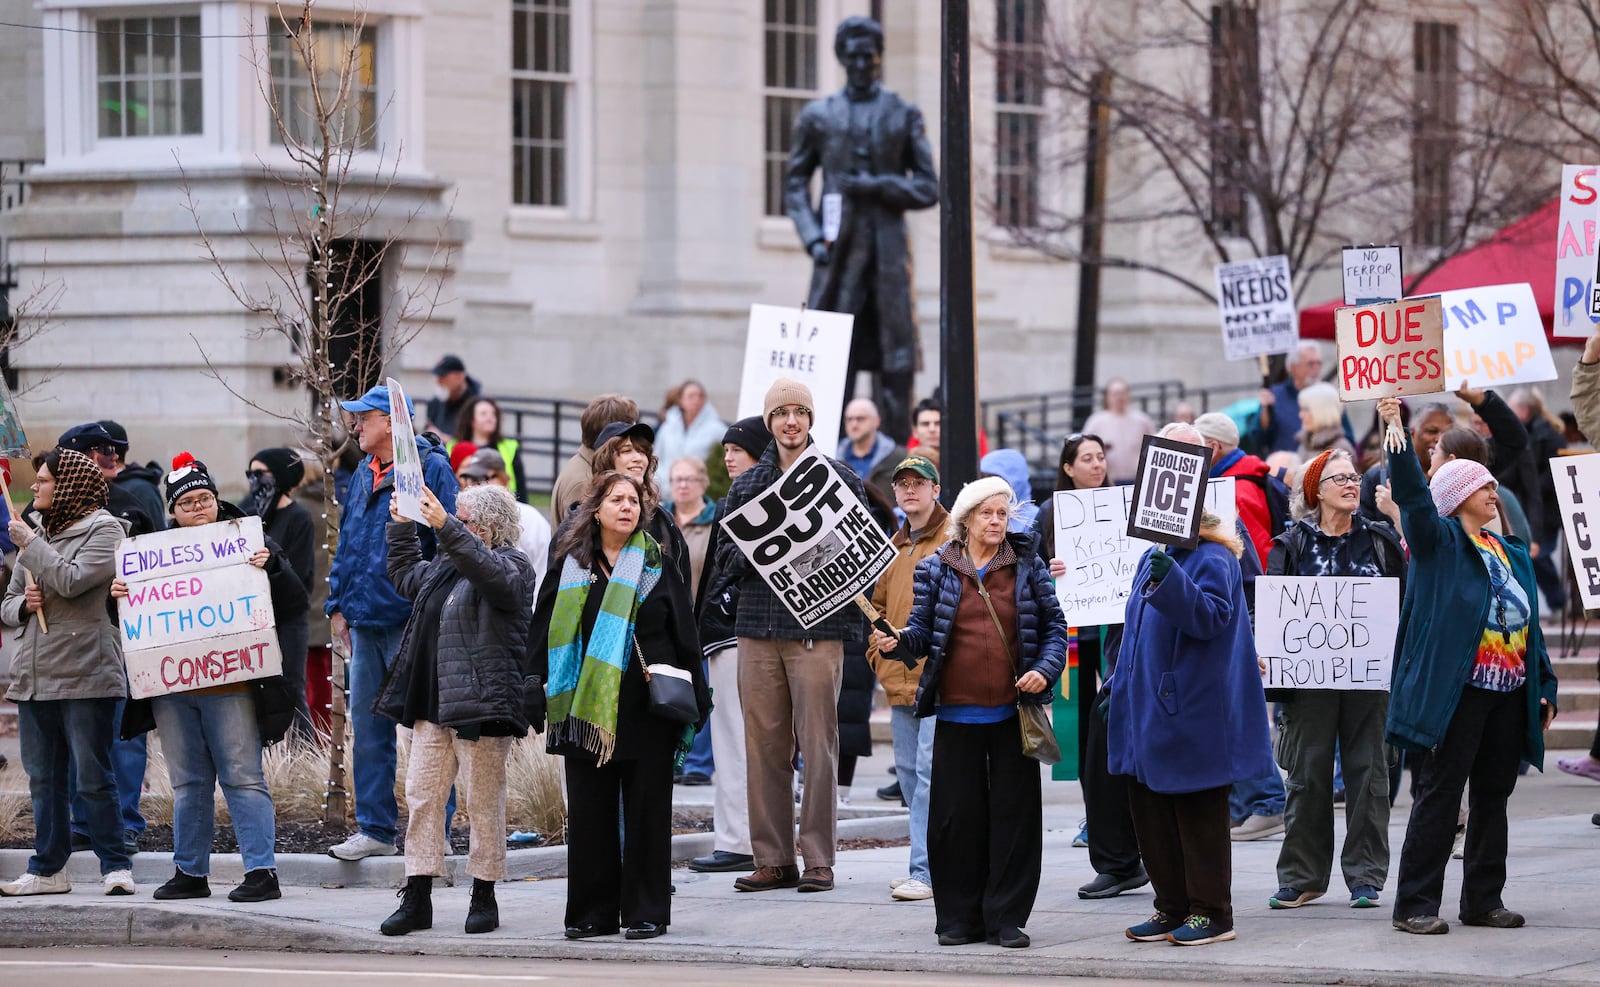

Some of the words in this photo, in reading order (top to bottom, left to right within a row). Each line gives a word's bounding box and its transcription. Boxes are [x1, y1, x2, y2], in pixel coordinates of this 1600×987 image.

[1346, 263, 1395, 277] TERROR
[1363, 251, 1379, 262] NO
[1221, 274, 1288, 309] NEEDS
[1225, 310, 1273, 324] NOT
[1355, 304, 1425, 348] DUE
[770, 350, 816, 373] RENEE
[1342, 348, 1442, 391] PROCESS
[1150, 450, 1198, 475] ABOLISH
[726, 455, 830, 542] US
[1144, 467, 1194, 516] ICE
[752, 480, 844, 566] OUT
[1140, 516, 1185, 535] UN-AMERICAN
[1142, 509, 1160, 518] SECRET
[1160, 513, 1176, 522] POLICE
[122, 543, 204, 576] ENDLESS
[211, 537, 251, 559] WAR
[769, 565, 796, 592] OF
[835, 504, 870, 542] THE
[783, 523, 887, 613] CARIBBEAN
[801, 607, 823, 624] PARTY
[820, 601, 835, 613] FOR
[831, 580, 862, 606] SOCIALISM
[859, 575, 869, 585] &
[865, 547, 894, 578] LIBERATION
[127, 577, 204, 608] WAGED
[123, 595, 257, 641] WITHOUT
[1283, 618, 1371, 654] GOOD
[160, 642, 270, 690] CONSENT
